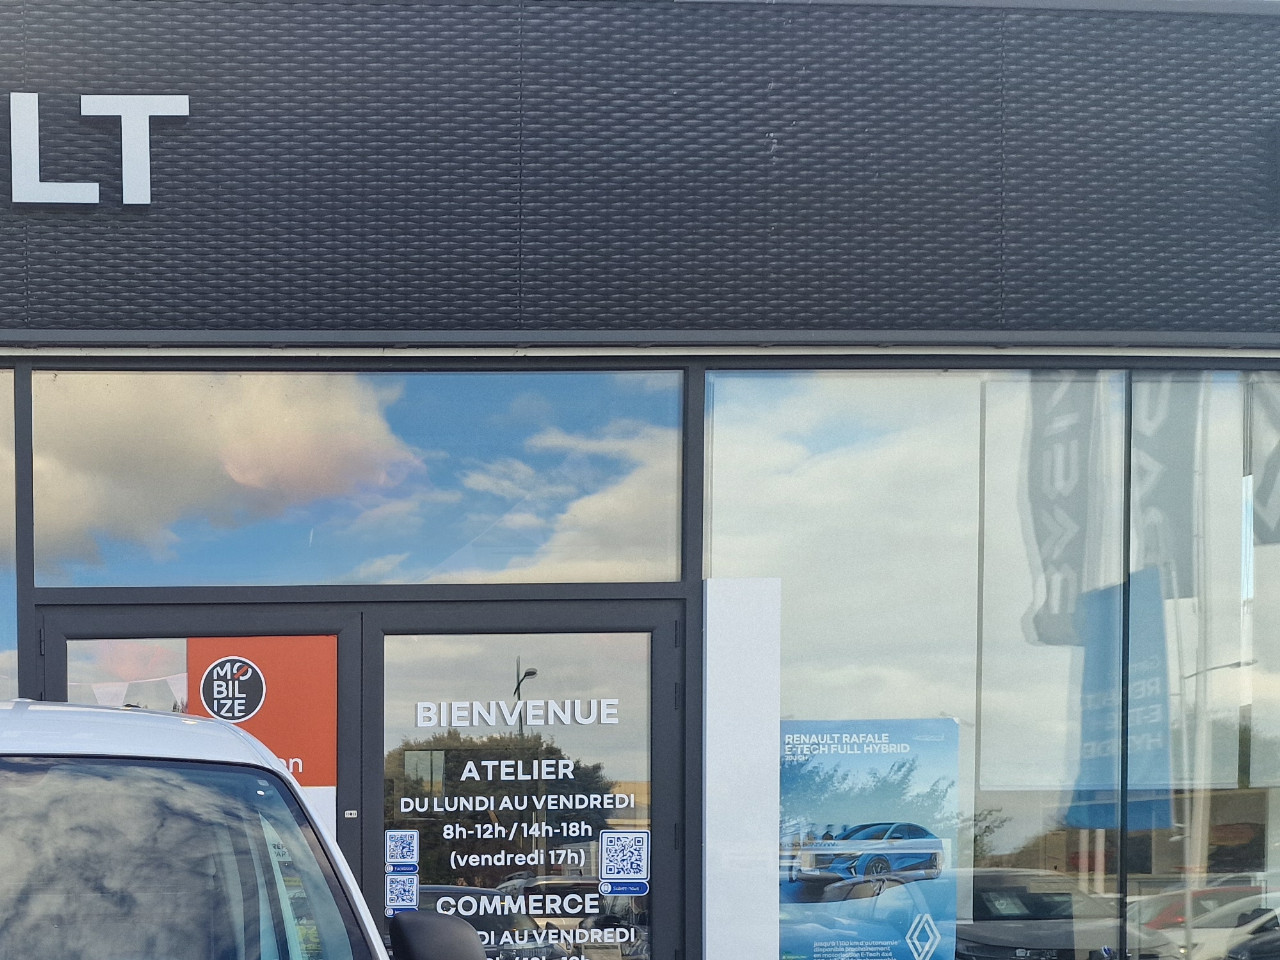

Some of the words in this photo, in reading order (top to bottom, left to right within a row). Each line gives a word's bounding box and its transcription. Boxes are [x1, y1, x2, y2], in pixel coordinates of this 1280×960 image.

[213, 680, 247, 698] BIL
[416, 698, 619, 727] BIENVENUE
[785, 734, 840, 744] RENAULT
[843, 733, 889, 743] RAFALE
[785, 744, 828, 755] E-TECH
[830, 744, 861, 754] FULL
[864, 743, 910, 753] HYBRID
[460, 759, 575, 781] ATELIER
[400, 797, 429, 813] DU
[434, 796, 495, 812] LUNDI
[499, 795, 528, 811] AU
[531, 793, 635, 810] VENDREDI
[442, 823, 507, 839] 8h-12h
[521, 821, 593, 838] 14h-18h
[450, 850, 544, 870] (vendredi
[549, 849, 586, 867] 17h)
[436, 893, 600, 917] COMMERCE
[499, 929, 529, 945] AU
[532, 928, 635, 944] VENDREDI
